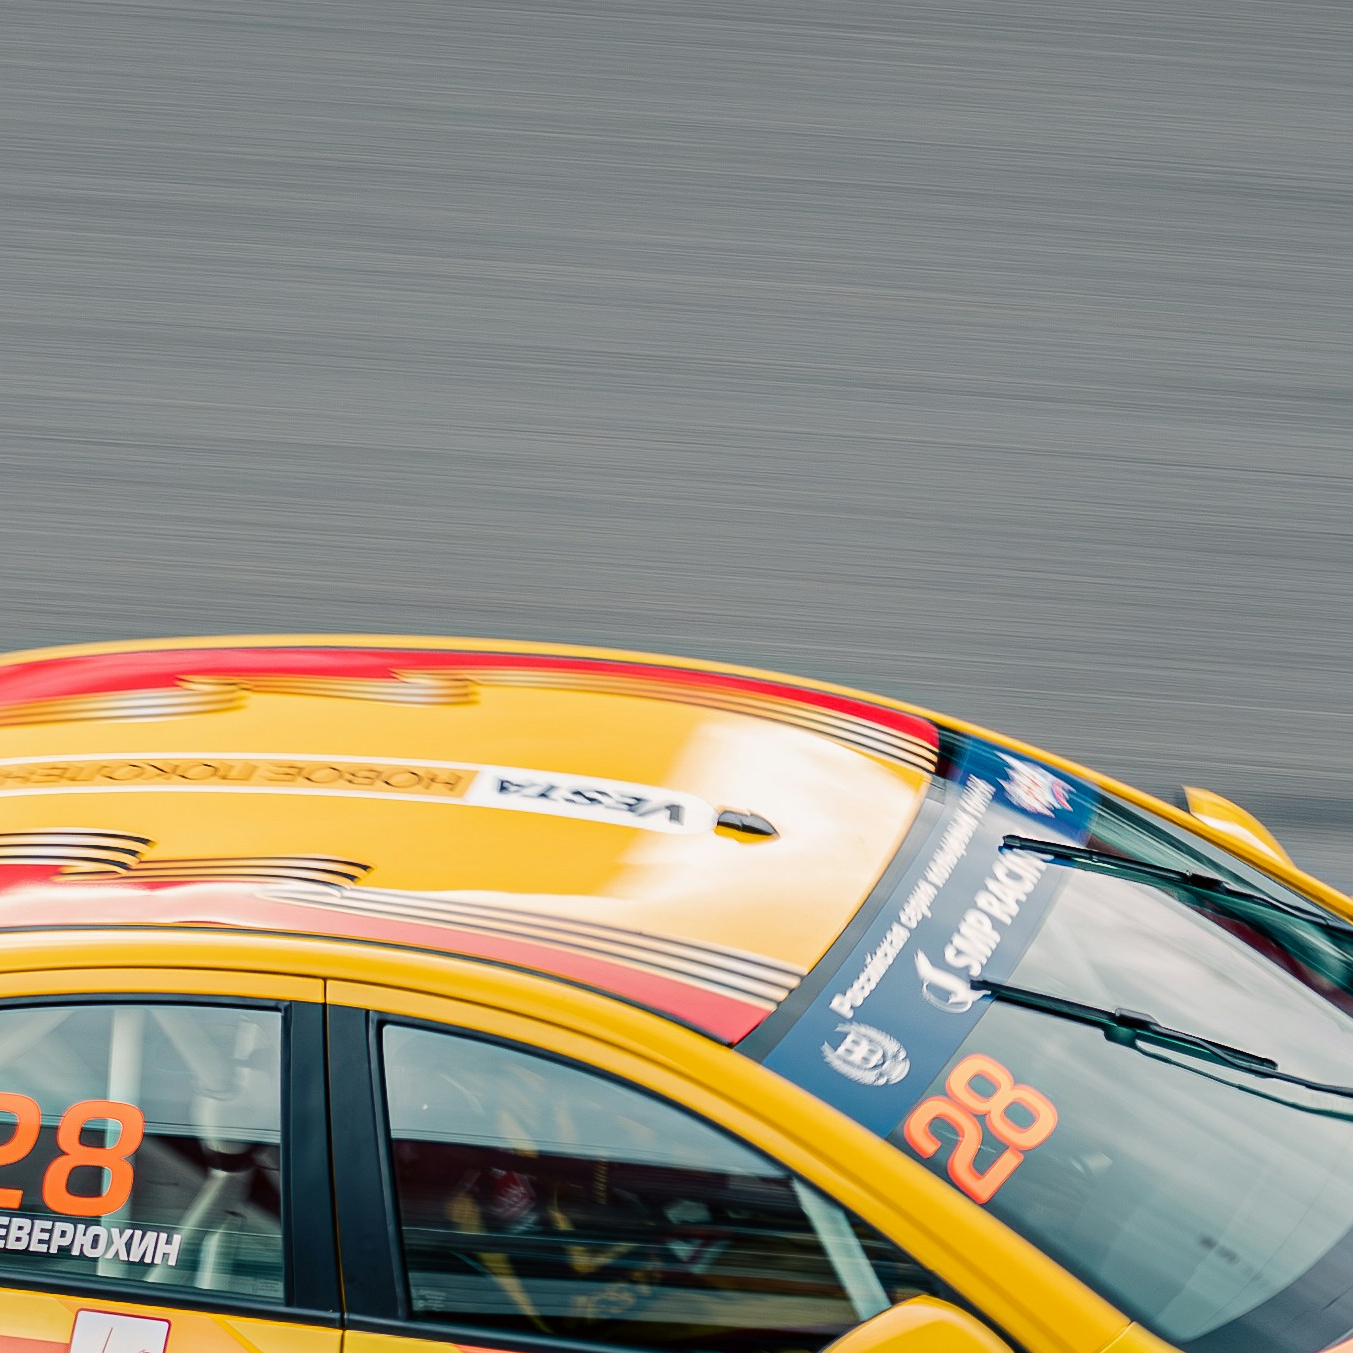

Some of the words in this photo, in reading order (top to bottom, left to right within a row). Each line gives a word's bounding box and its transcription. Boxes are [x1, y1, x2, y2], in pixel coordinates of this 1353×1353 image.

[267, 763, 464, 793] НОВОЕ
[491, 777, 686, 827] VESTA
[944, 907, 1001, 977] SMP
[974, 848, 1054, 927] RACIN
[903, 1053, 1058, 1205] 28
